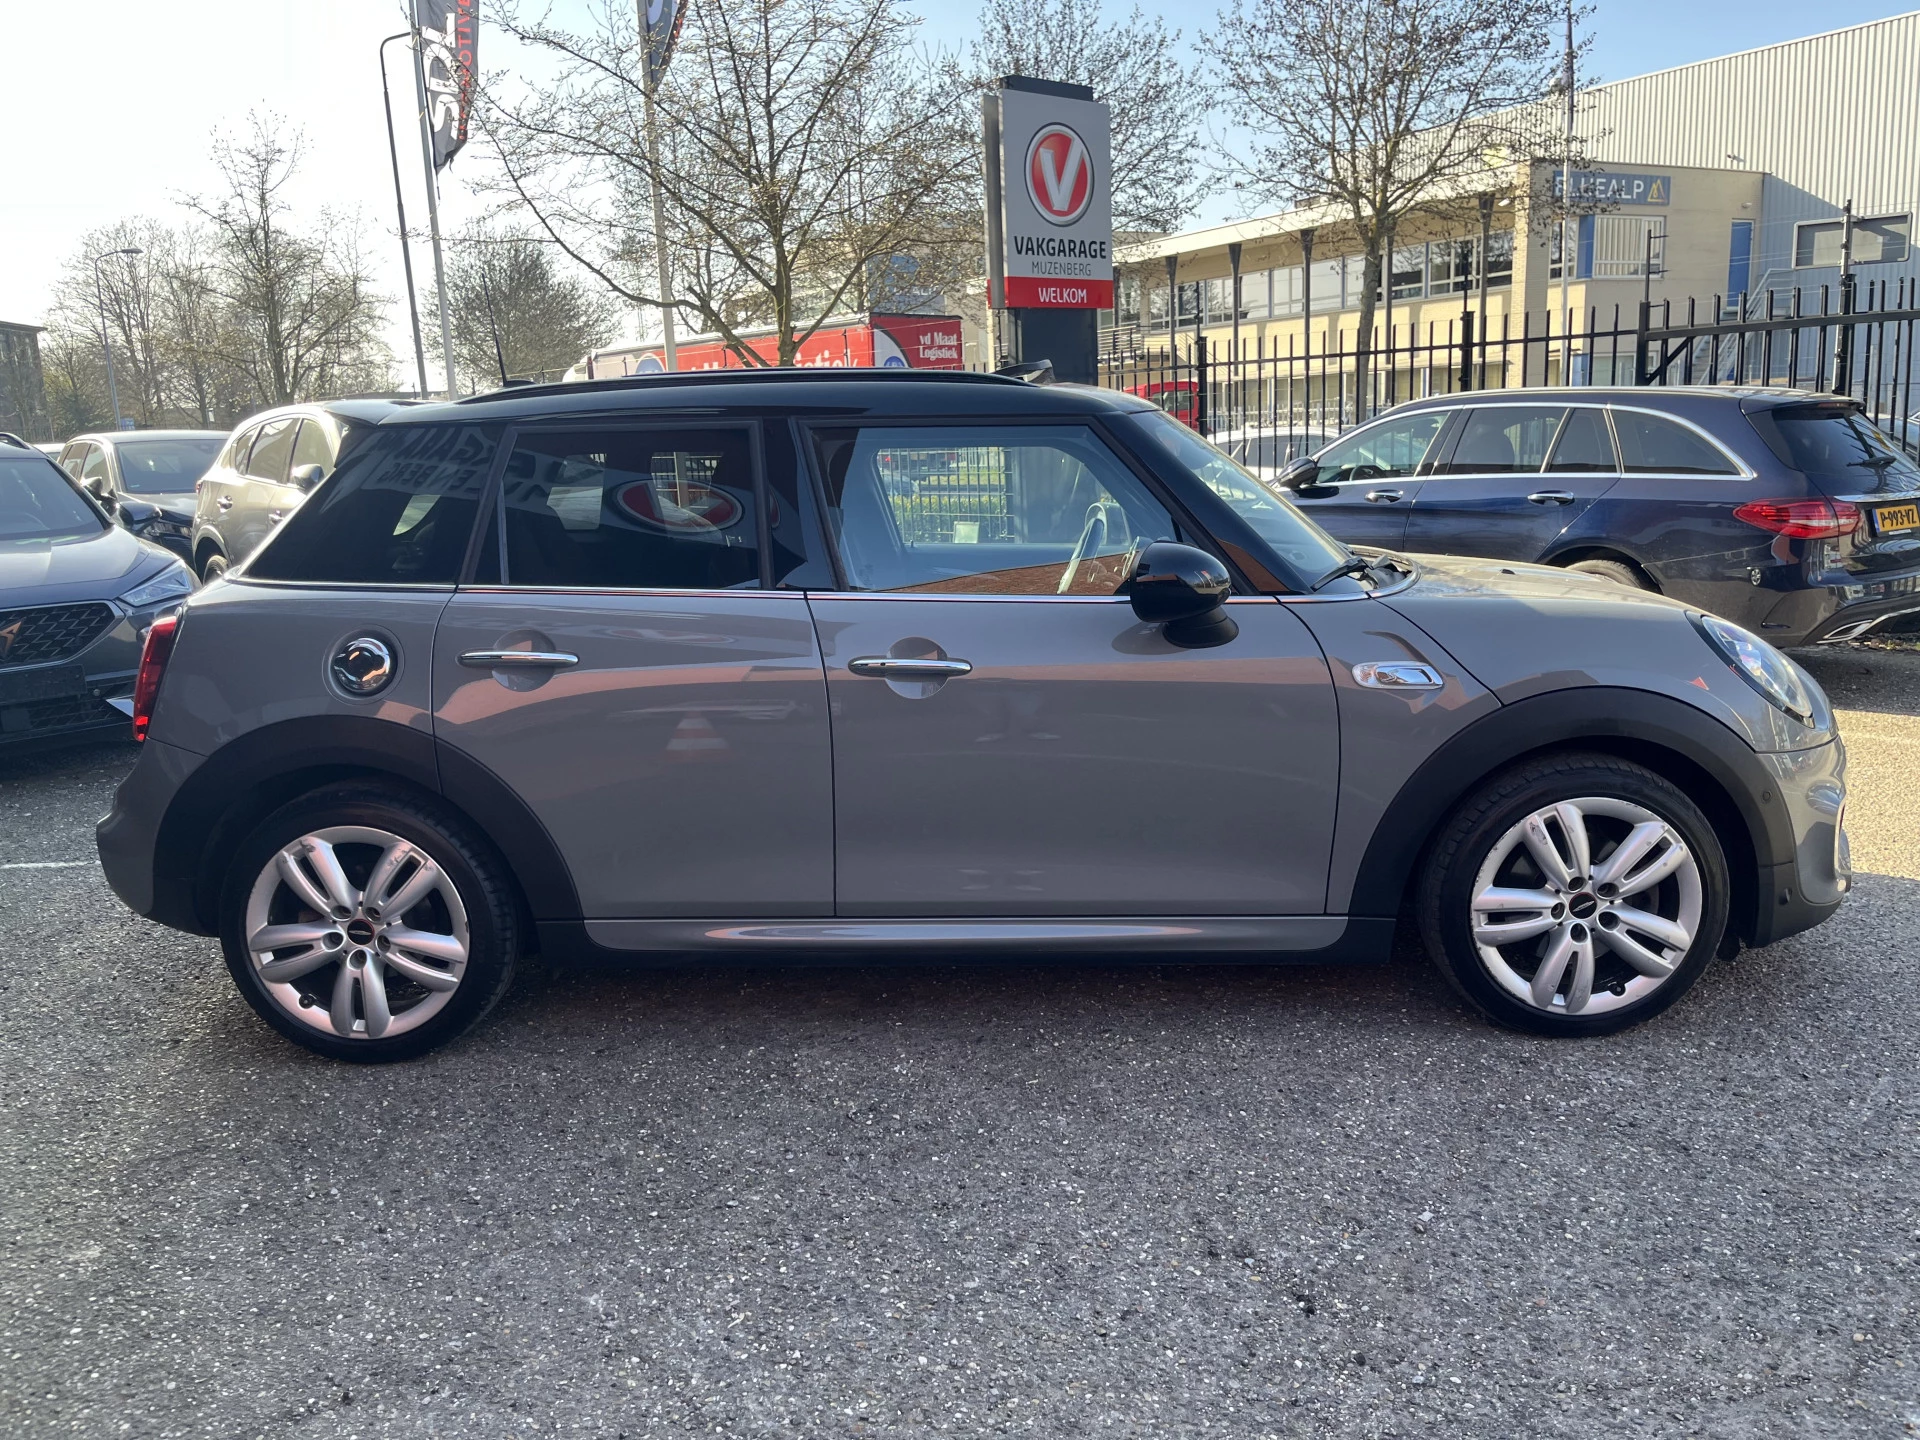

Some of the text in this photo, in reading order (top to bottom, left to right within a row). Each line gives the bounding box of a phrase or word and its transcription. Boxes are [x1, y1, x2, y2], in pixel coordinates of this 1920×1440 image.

[422, 13, 459, 141] SDL
[1014, 235, 1107, 259] VAKGARAGE
[1032, 261, 1092, 276] MUZENBERG
[1038, 287, 1088, 304] WELKOM
[919, 332, 957, 346] vd Maat
[919, 346, 958, 361] Logistiek
[1880, 508, 1917, 528] P-993-VZ
